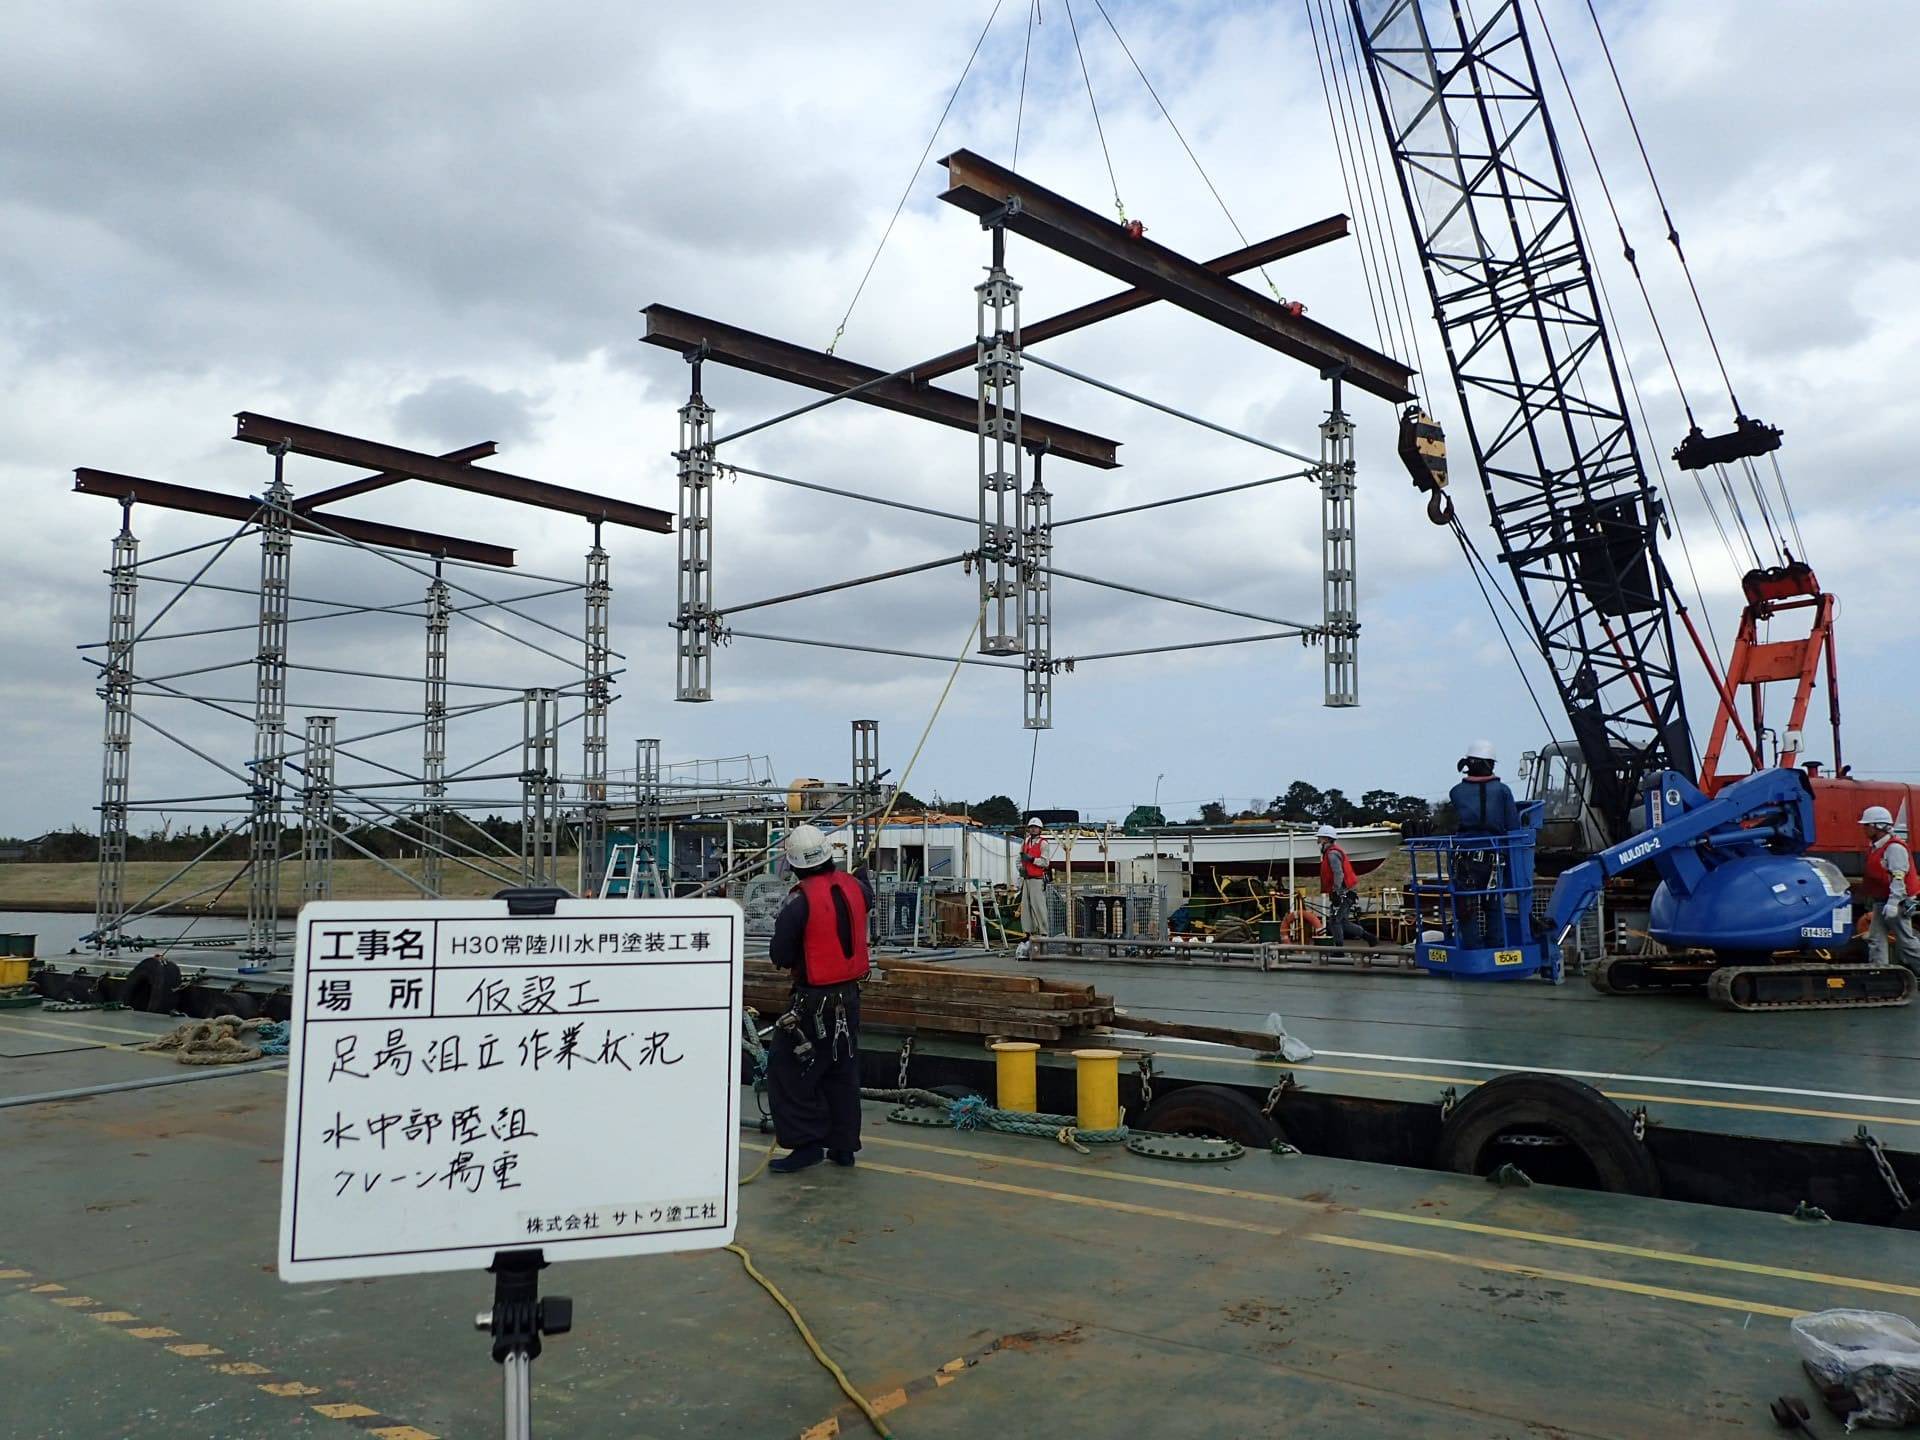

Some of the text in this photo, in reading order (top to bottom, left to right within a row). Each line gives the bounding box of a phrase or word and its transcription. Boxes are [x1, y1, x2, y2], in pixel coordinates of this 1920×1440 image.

[319, 928, 425, 961] 工事名
[451, 931, 711, 956] H30常陸川水門塗装工事
[465, 975, 600, 1015] 仮設工
[327, 1022, 685, 1083] 足場組立作業状況
[526, 1211, 600, 1235] 株式会社
